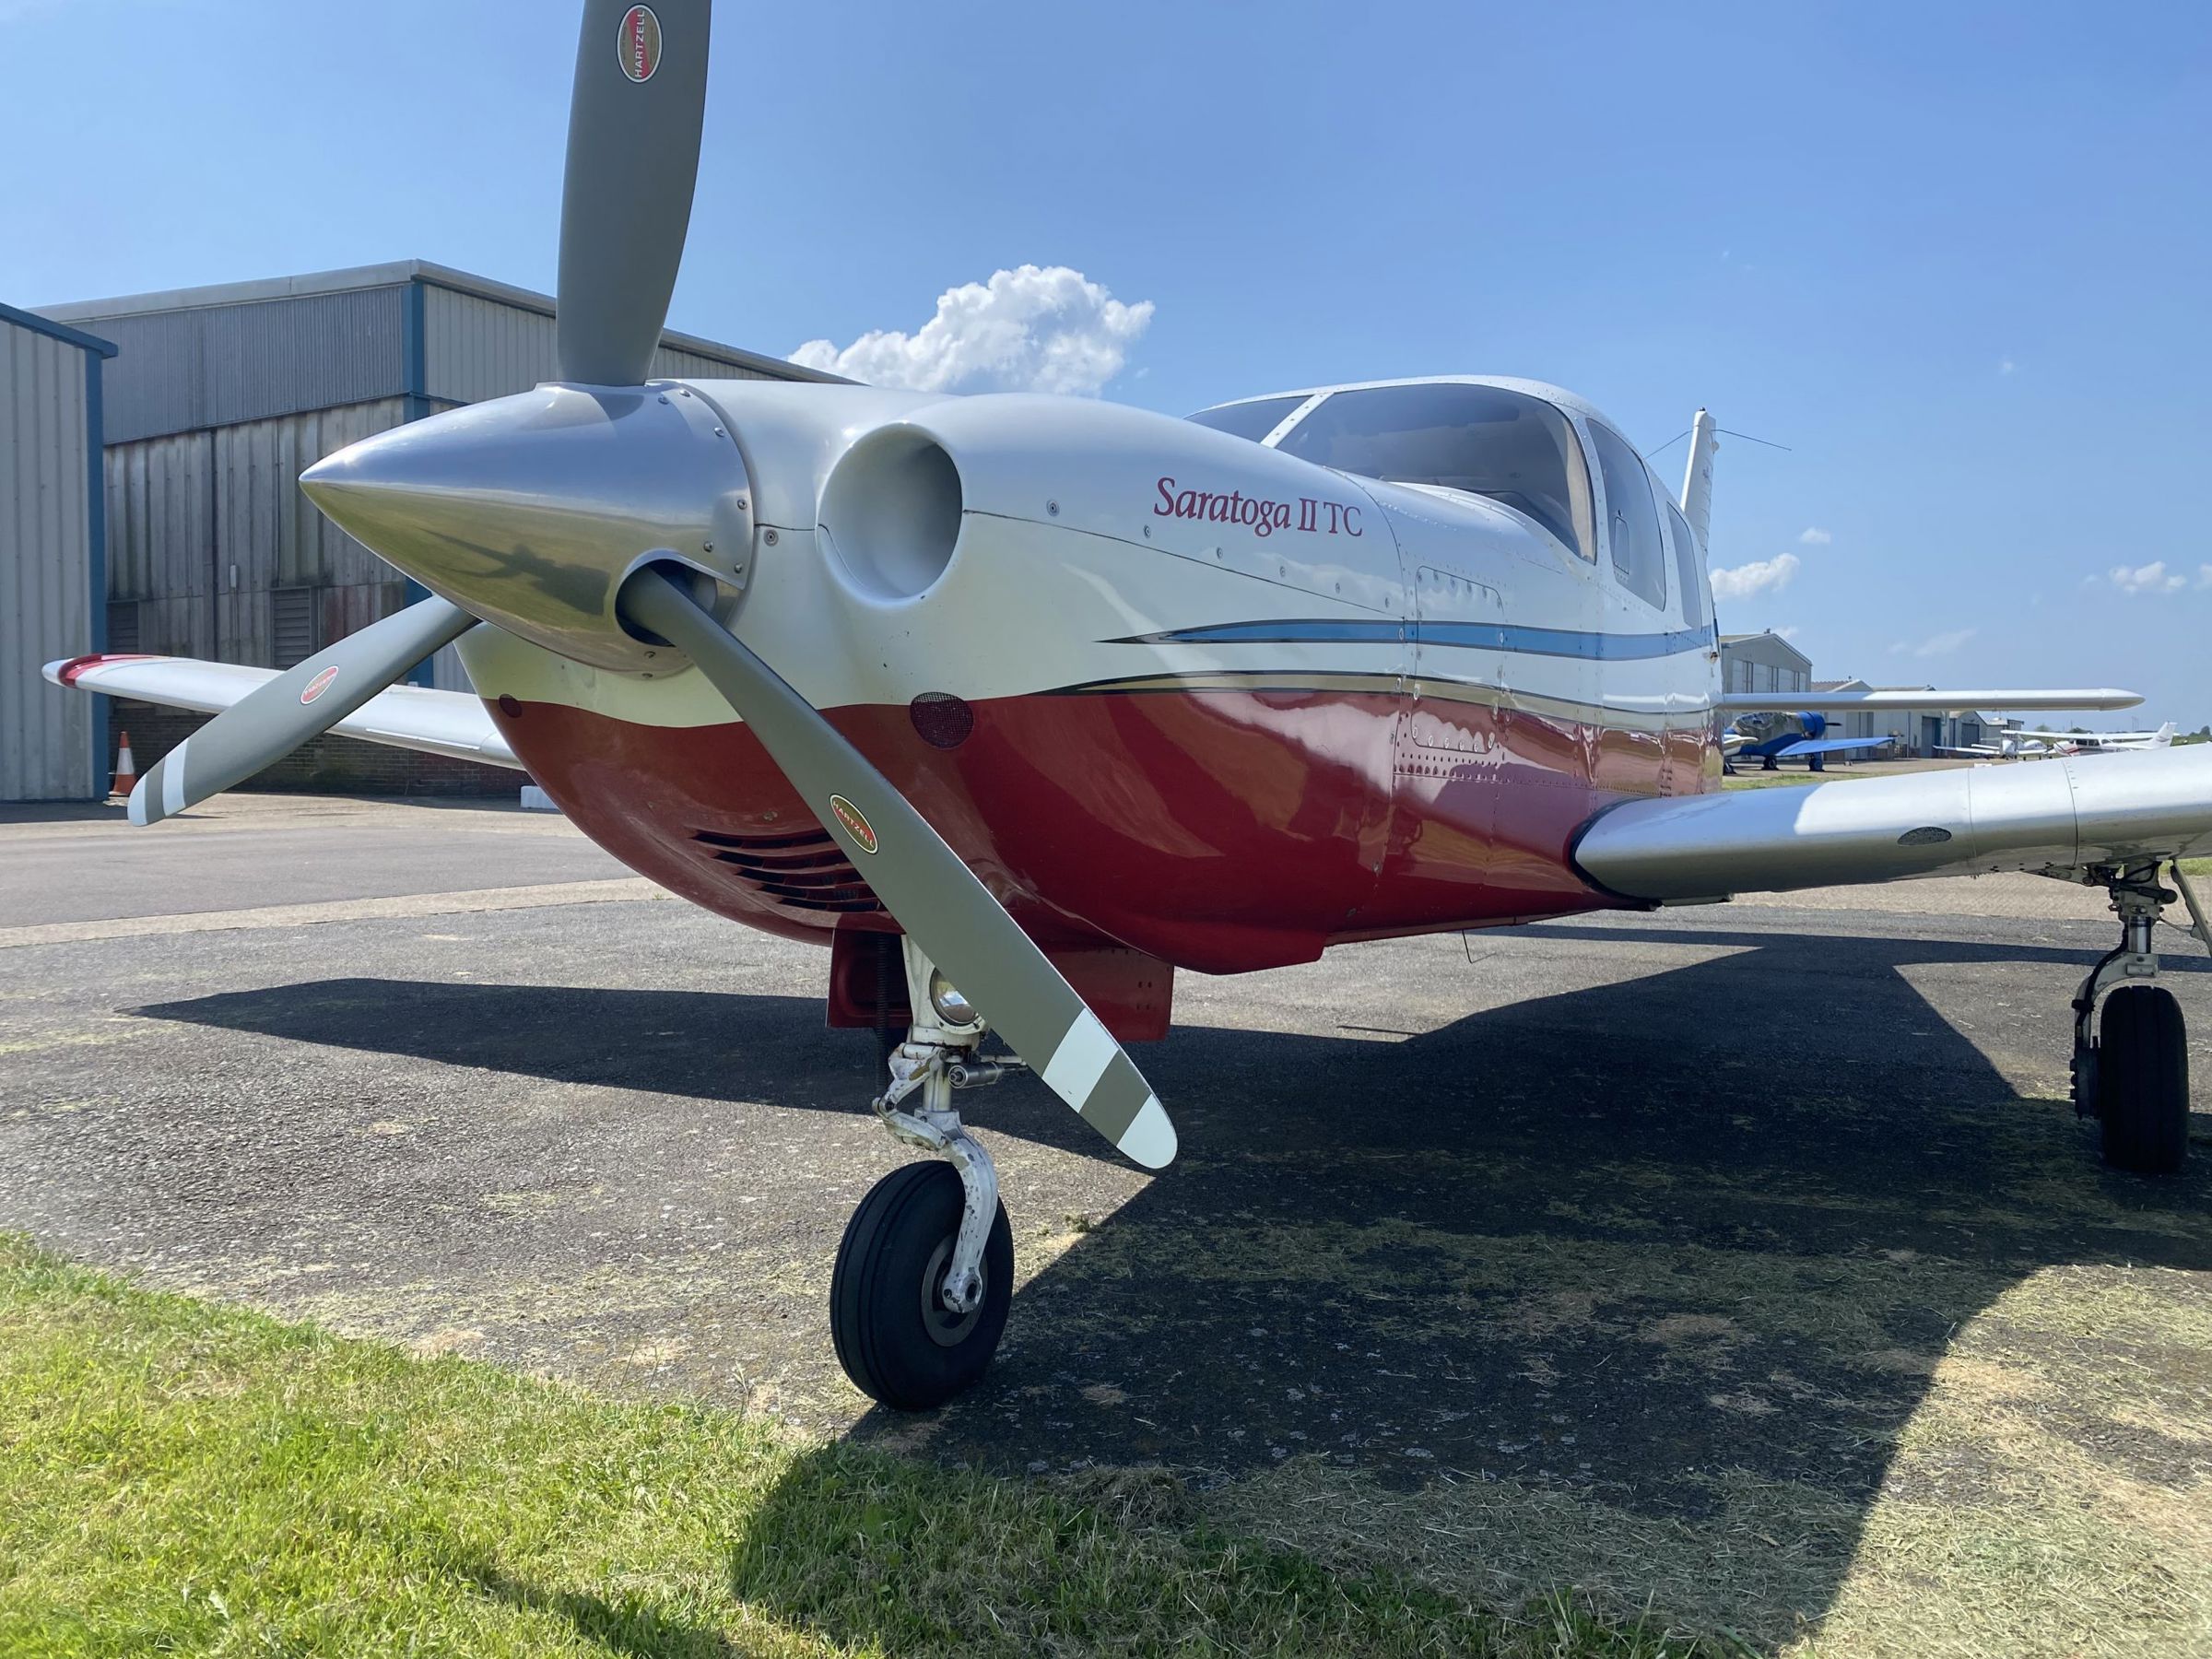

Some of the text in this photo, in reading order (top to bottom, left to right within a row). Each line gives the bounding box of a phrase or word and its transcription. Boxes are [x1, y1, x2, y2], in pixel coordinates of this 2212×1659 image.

[634, 9, 646, 78] HARTZELL
[1154, 477, 1362, 537] Saratoga II TC
[832, 800, 875, 849] HARTZELL
